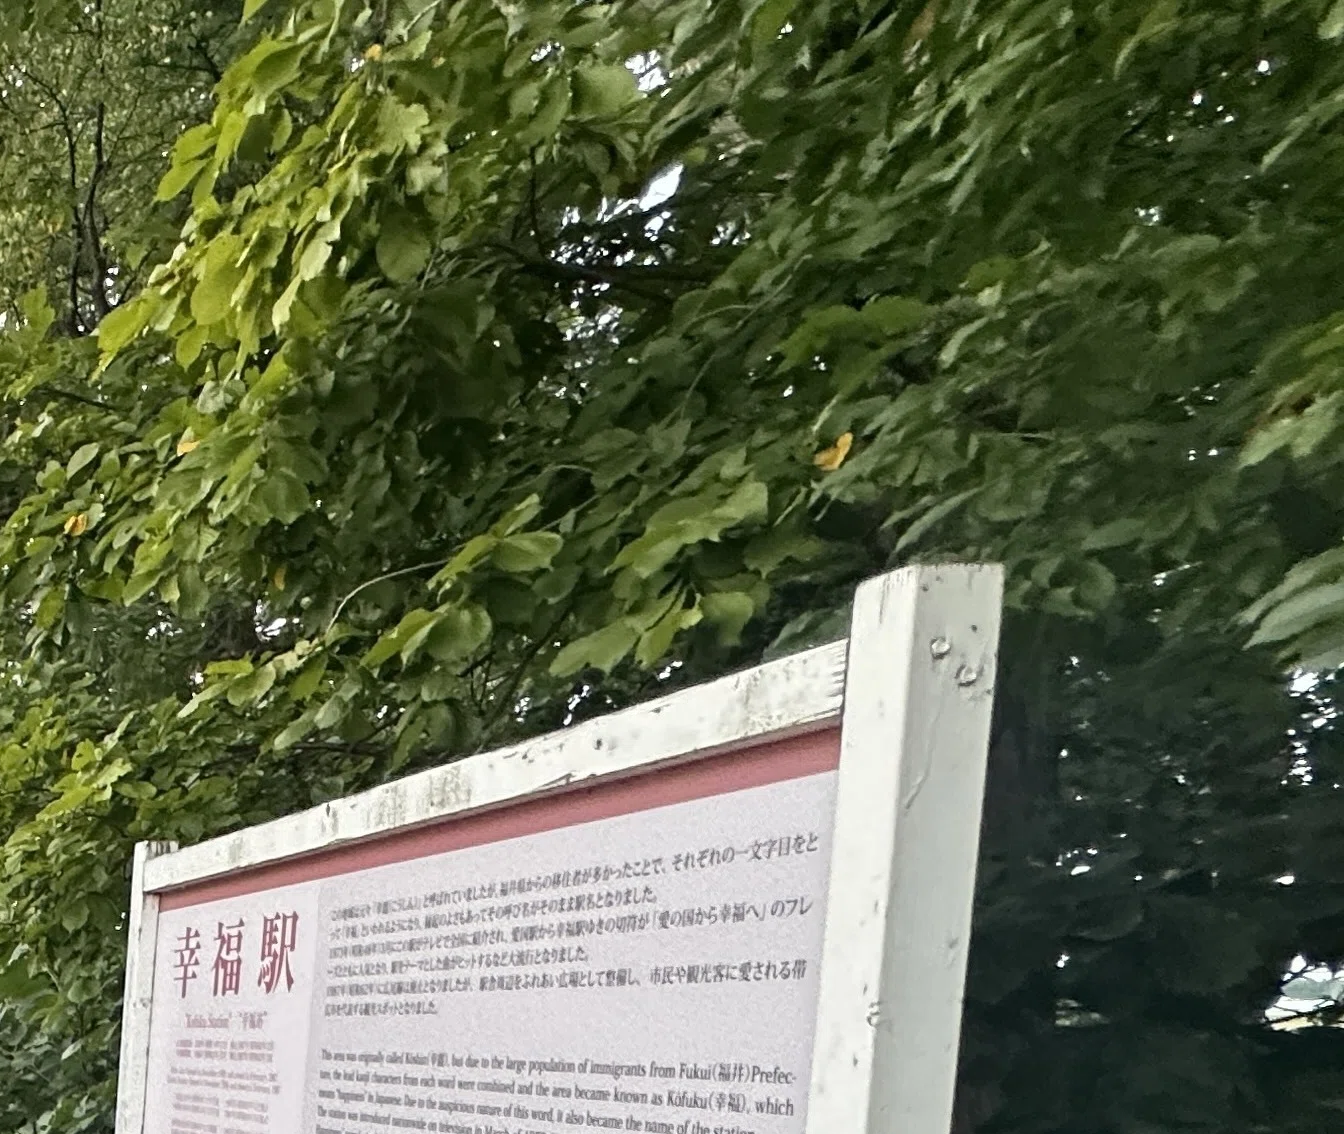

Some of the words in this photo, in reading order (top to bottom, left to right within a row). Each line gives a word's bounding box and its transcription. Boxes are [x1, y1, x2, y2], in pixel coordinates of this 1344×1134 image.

[172, 909, 299, 999] 幸福駅
[480, 1057, 489, 1068] to
[490, 1056, 504, 1069] the
[505, 1056, 526, 1074] large
[527, 1058, 575, 1075] population
[577, 1059, 589, 1074] of
[589, 1059, 646, 1080] immigrants
[649, 1062, 676, 1078] from
[516, 1081, 533, 1095] and
[535, 1082, 549, 1096] the
[551, 1087, 571, 1098] area
[573, 1084, 611, 1101] became
[613, 1087, 647, 1104] known
[650, 1094, 663, 1106] as
[754, 1097, 795, 1116] which
[503, 1103, 512, 1117] of
[513, 1104, 529, 1119] this
[556, 1108, 563, 1122] it
[565, 1109, 584, 1125] also
[585, 1110, 623, 1129] became
[625, 1114, 643, 1131] the
[644, 1121, 675, 1134] name
